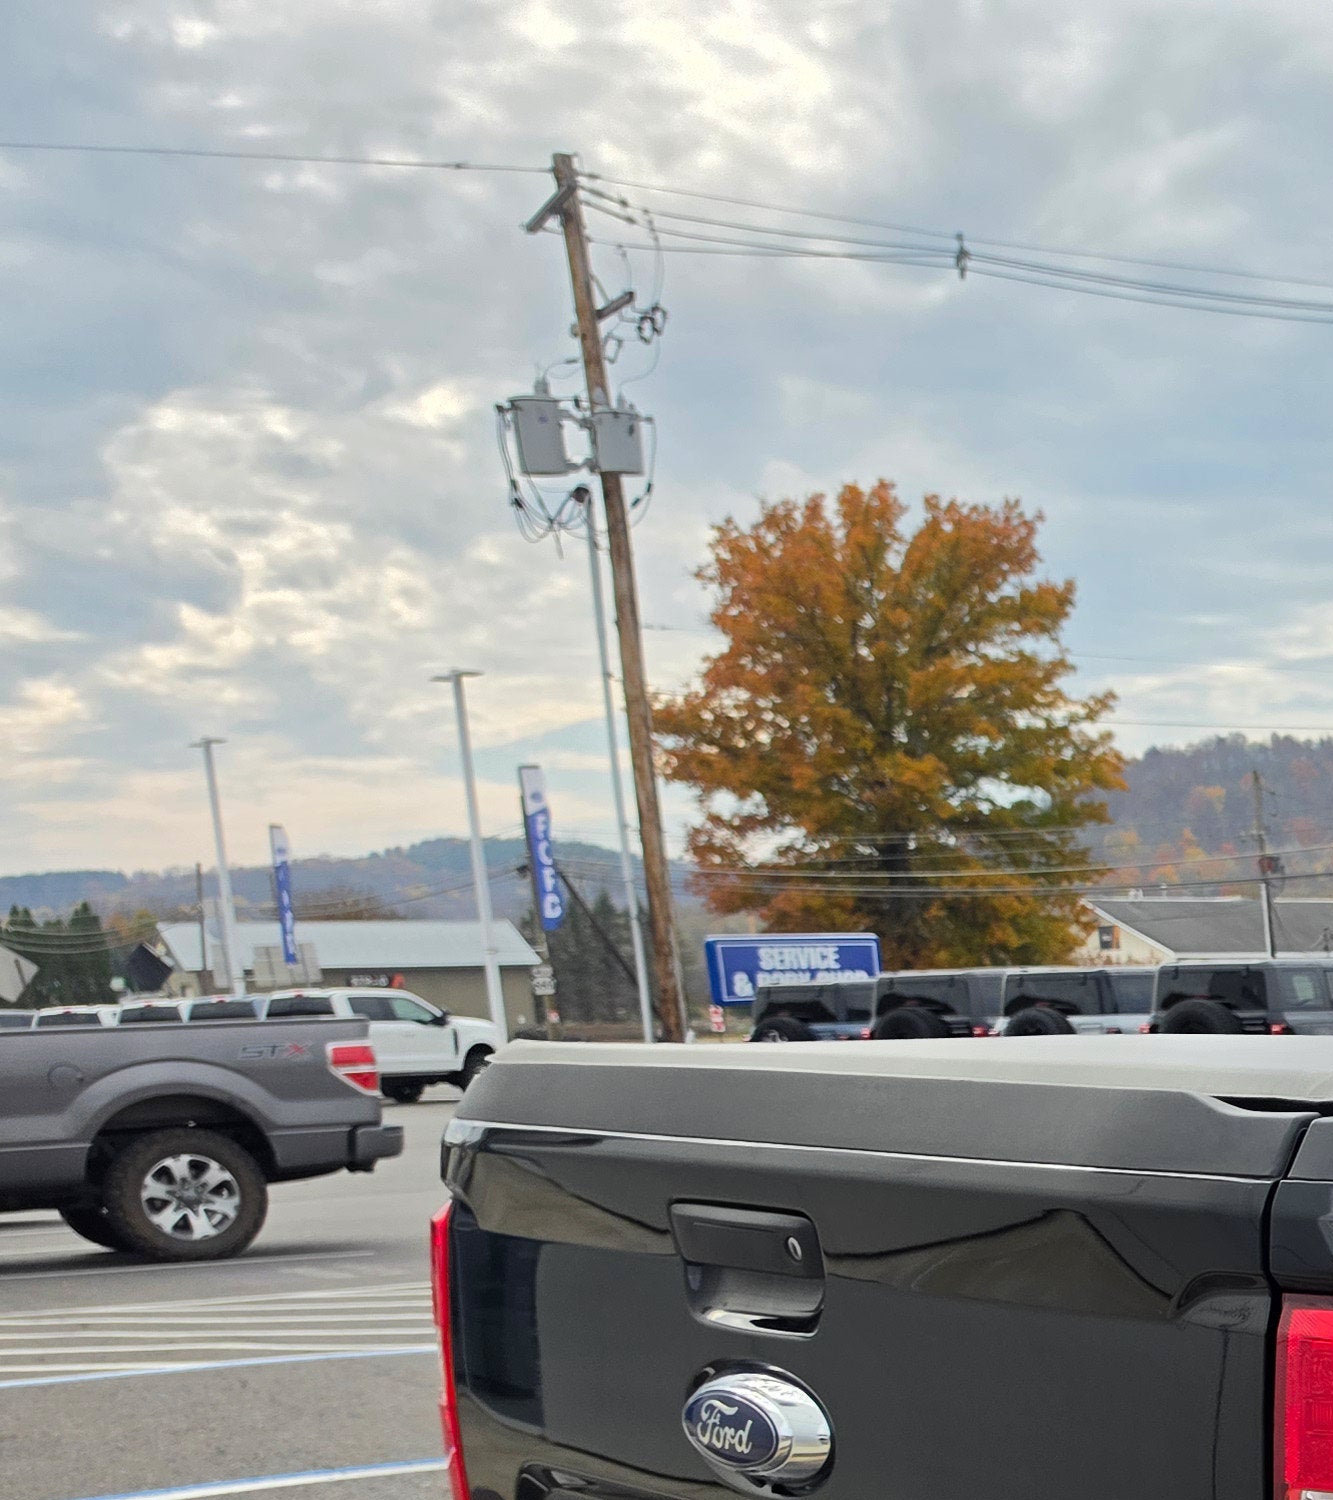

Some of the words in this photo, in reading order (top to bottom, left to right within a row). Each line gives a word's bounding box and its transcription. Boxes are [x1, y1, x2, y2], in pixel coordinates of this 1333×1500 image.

[757, 946, 841, 970] SERVICE
[733, 971, 754, 997] &
[240, 1043, 310, 1060] STX
[697, 1399, 753, 1454] Ford
